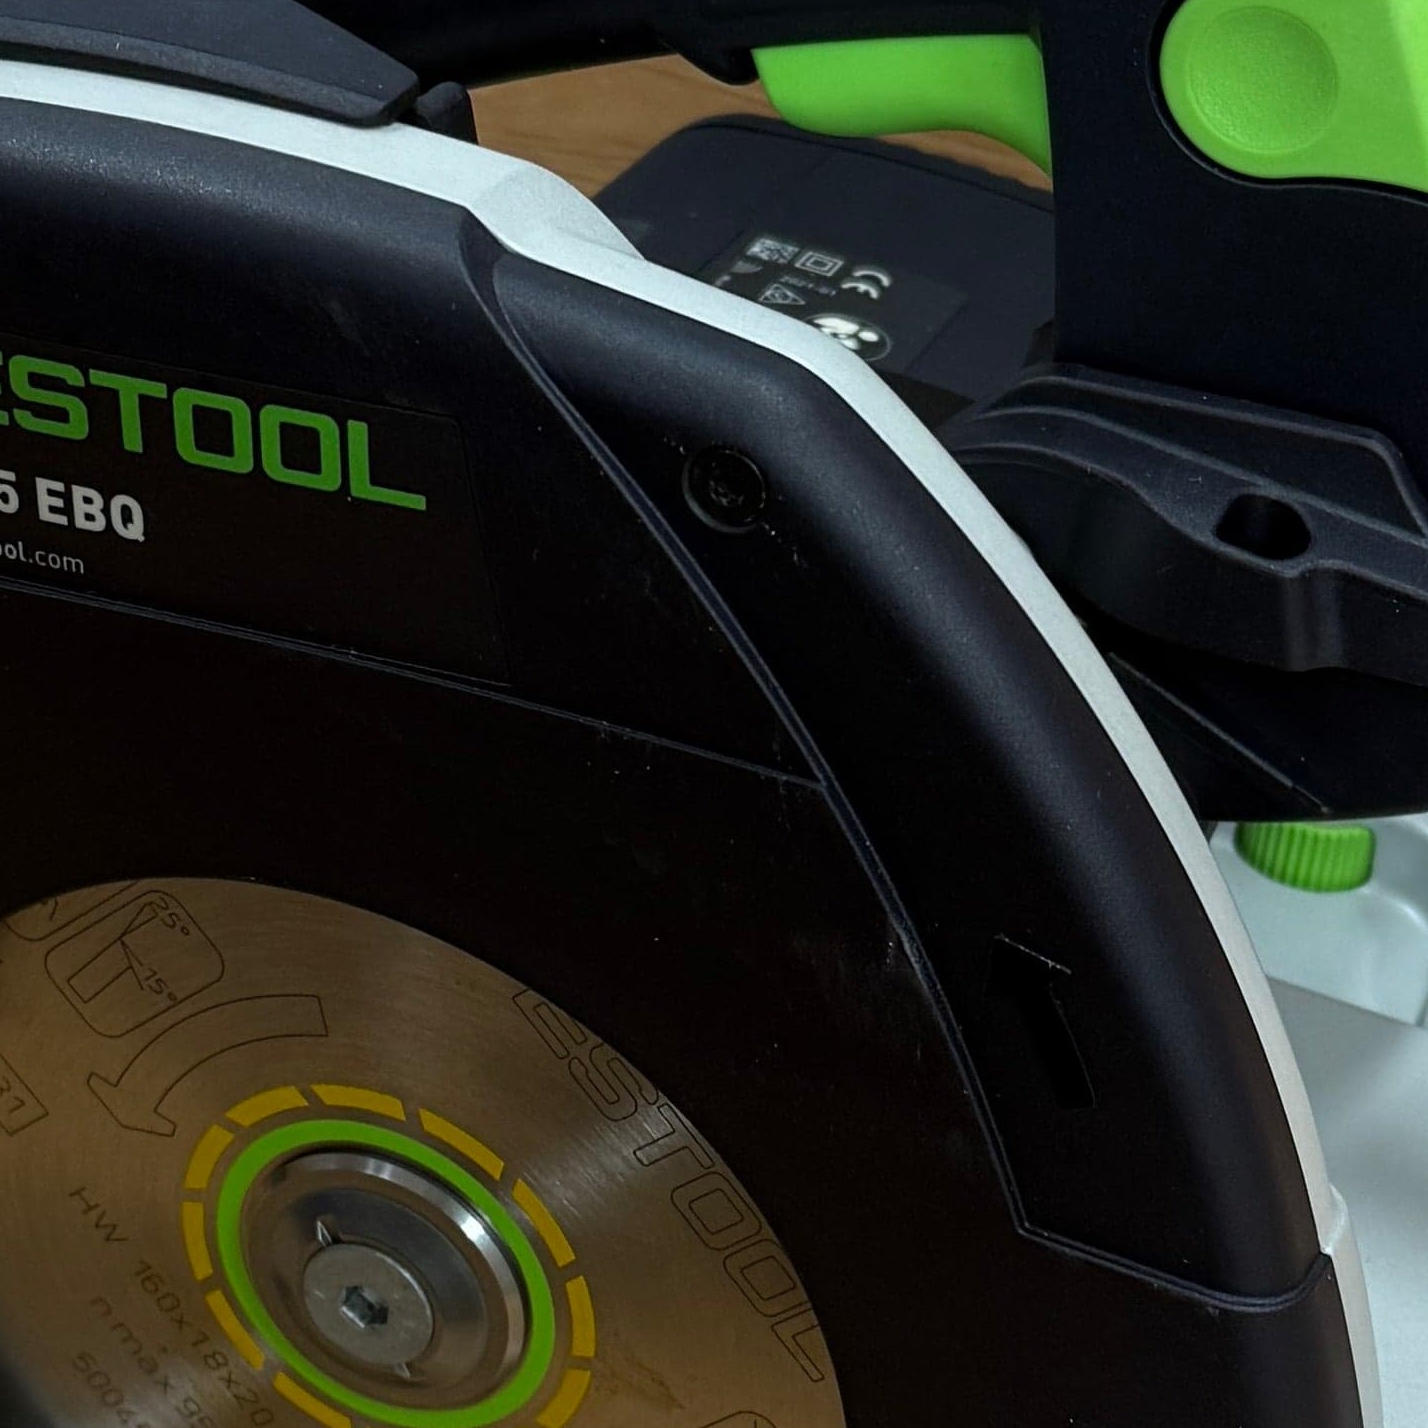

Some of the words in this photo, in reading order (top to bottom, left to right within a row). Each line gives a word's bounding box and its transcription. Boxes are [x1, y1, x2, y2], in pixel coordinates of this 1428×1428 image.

[35, 475, 146, 543] EBQ
[69, 1186, 130, 1246] HW
[511, 987, 825, 1384] ESTOOL
